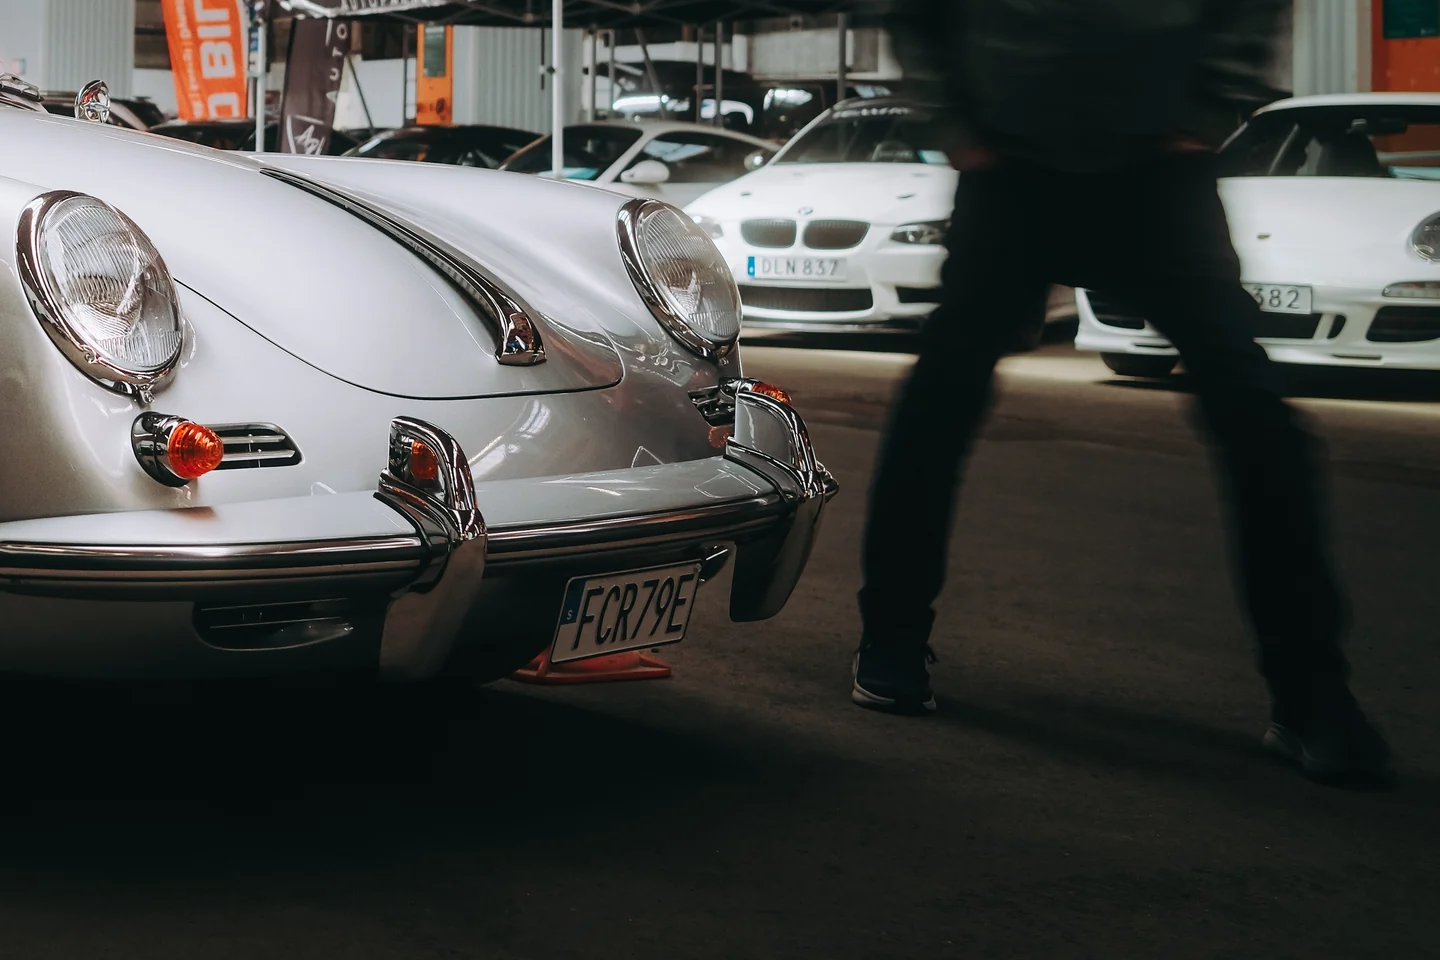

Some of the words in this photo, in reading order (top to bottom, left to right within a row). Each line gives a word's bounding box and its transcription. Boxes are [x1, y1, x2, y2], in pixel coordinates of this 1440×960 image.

[762, 258, 795, 275] DLN
[802, 258, 839, 276] 837
[572, 574, 695, 650] FCR79E
